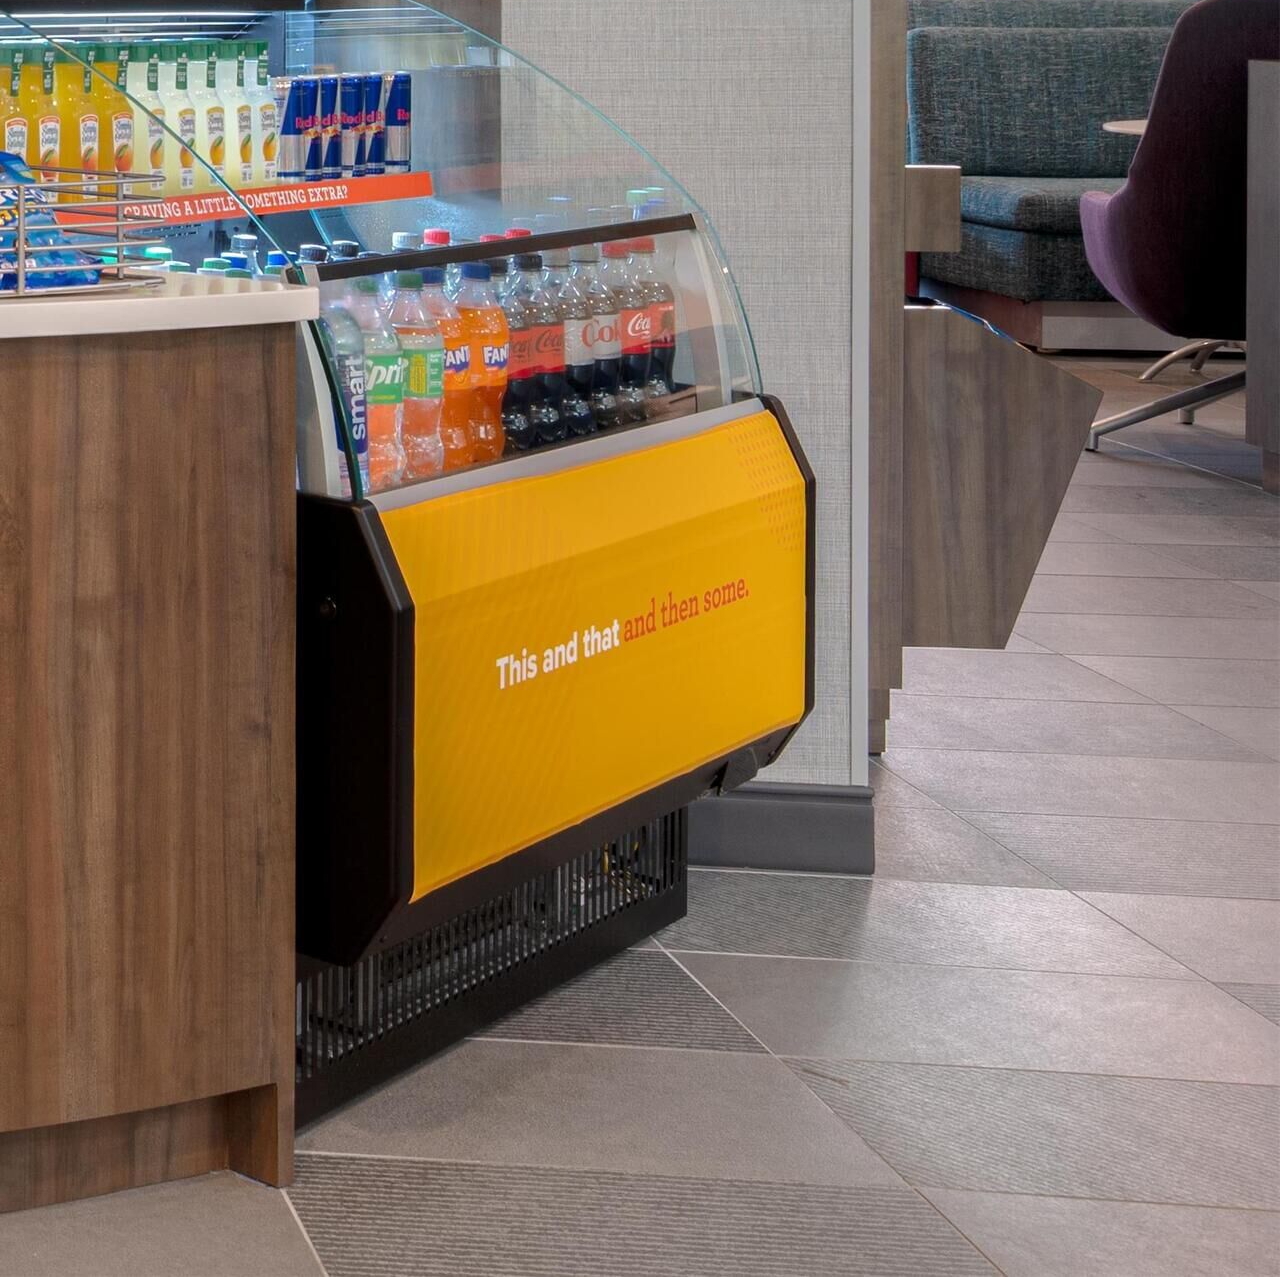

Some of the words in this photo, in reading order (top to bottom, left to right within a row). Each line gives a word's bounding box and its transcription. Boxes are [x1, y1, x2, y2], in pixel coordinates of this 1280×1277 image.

[184, 200, 194, 215] A
[196, 195, 235, 214] LITTLE
[309, 185, 348, 202] EXTRA?
[345, 355, 367, 441] smart
[496, 647, 538, 689] This
[543, 631, 578, 673] and
[583, 619, 620, 658] that
[624, 597, 657, 642] and
[660, 591, 700, 629] then
[703, 578, 750, 612] some.
